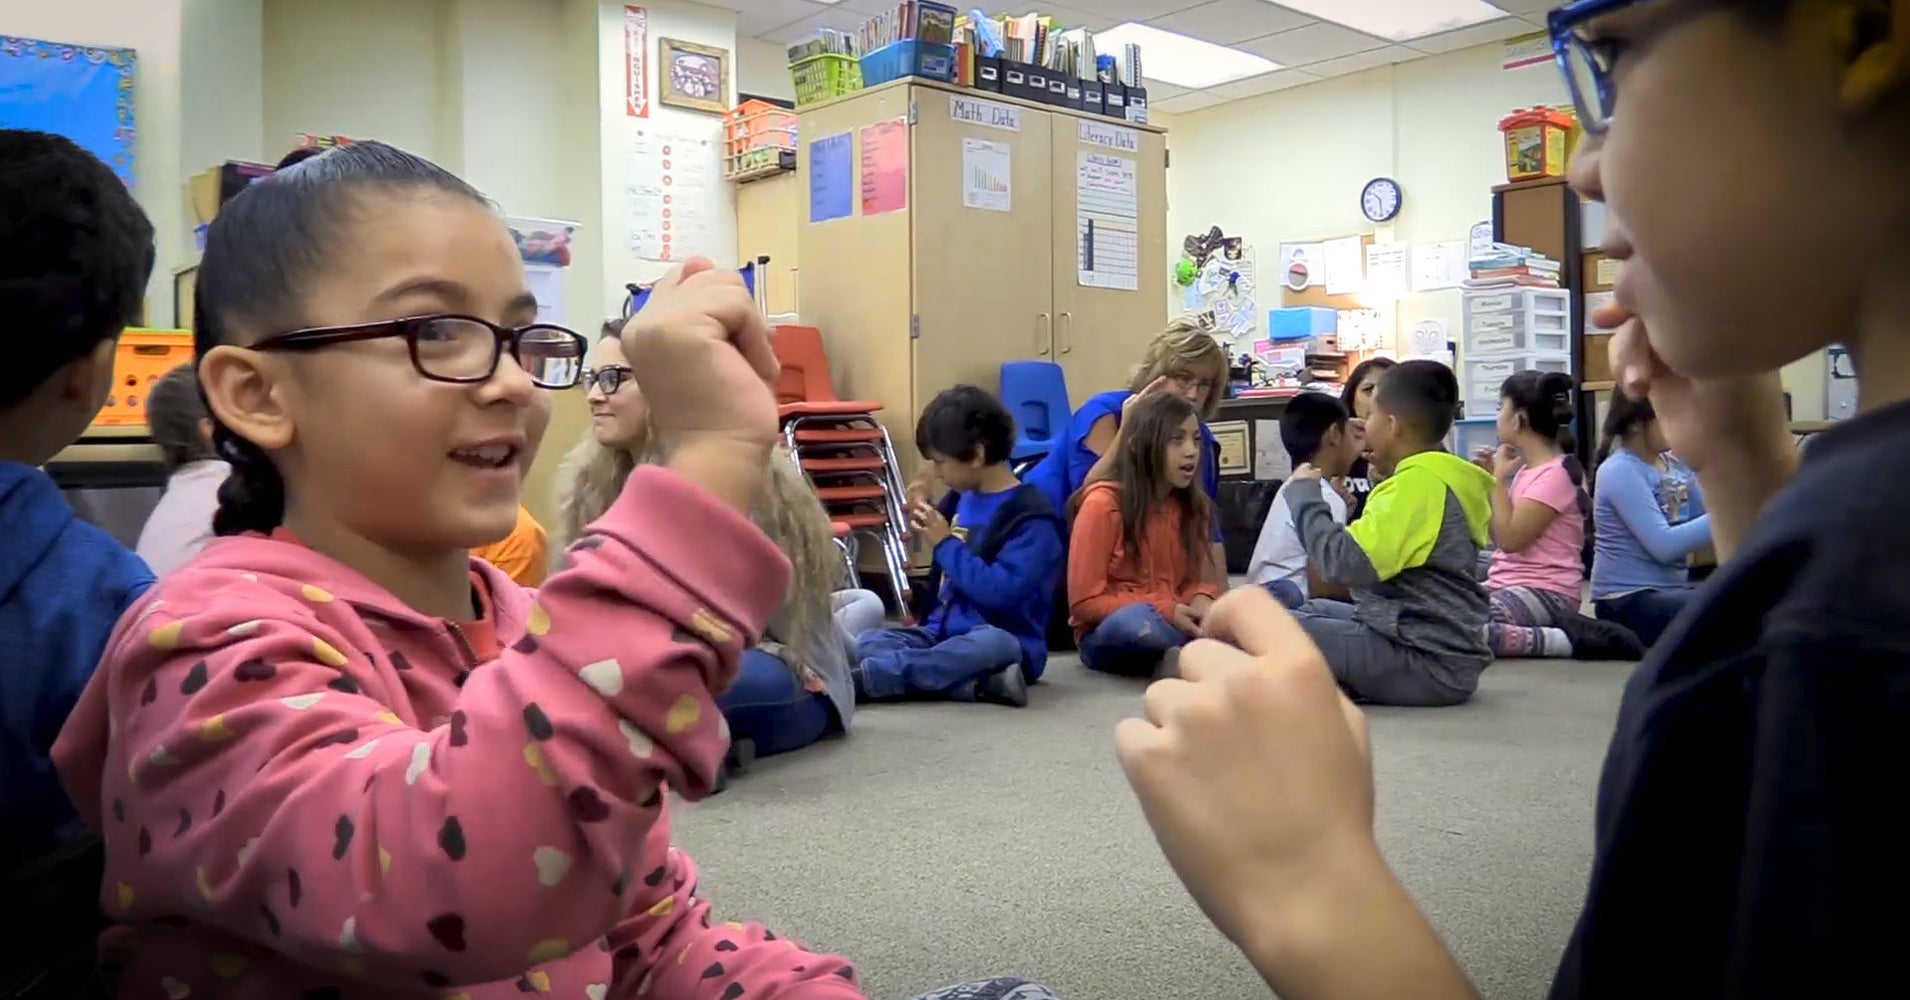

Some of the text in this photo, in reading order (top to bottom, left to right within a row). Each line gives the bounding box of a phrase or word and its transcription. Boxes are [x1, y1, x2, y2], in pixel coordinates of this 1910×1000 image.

[632, 30, 642, 109] INGUISHER
[953, 100, 1015, 127] Math Data
[1115, 130, 1135, 149] Data
